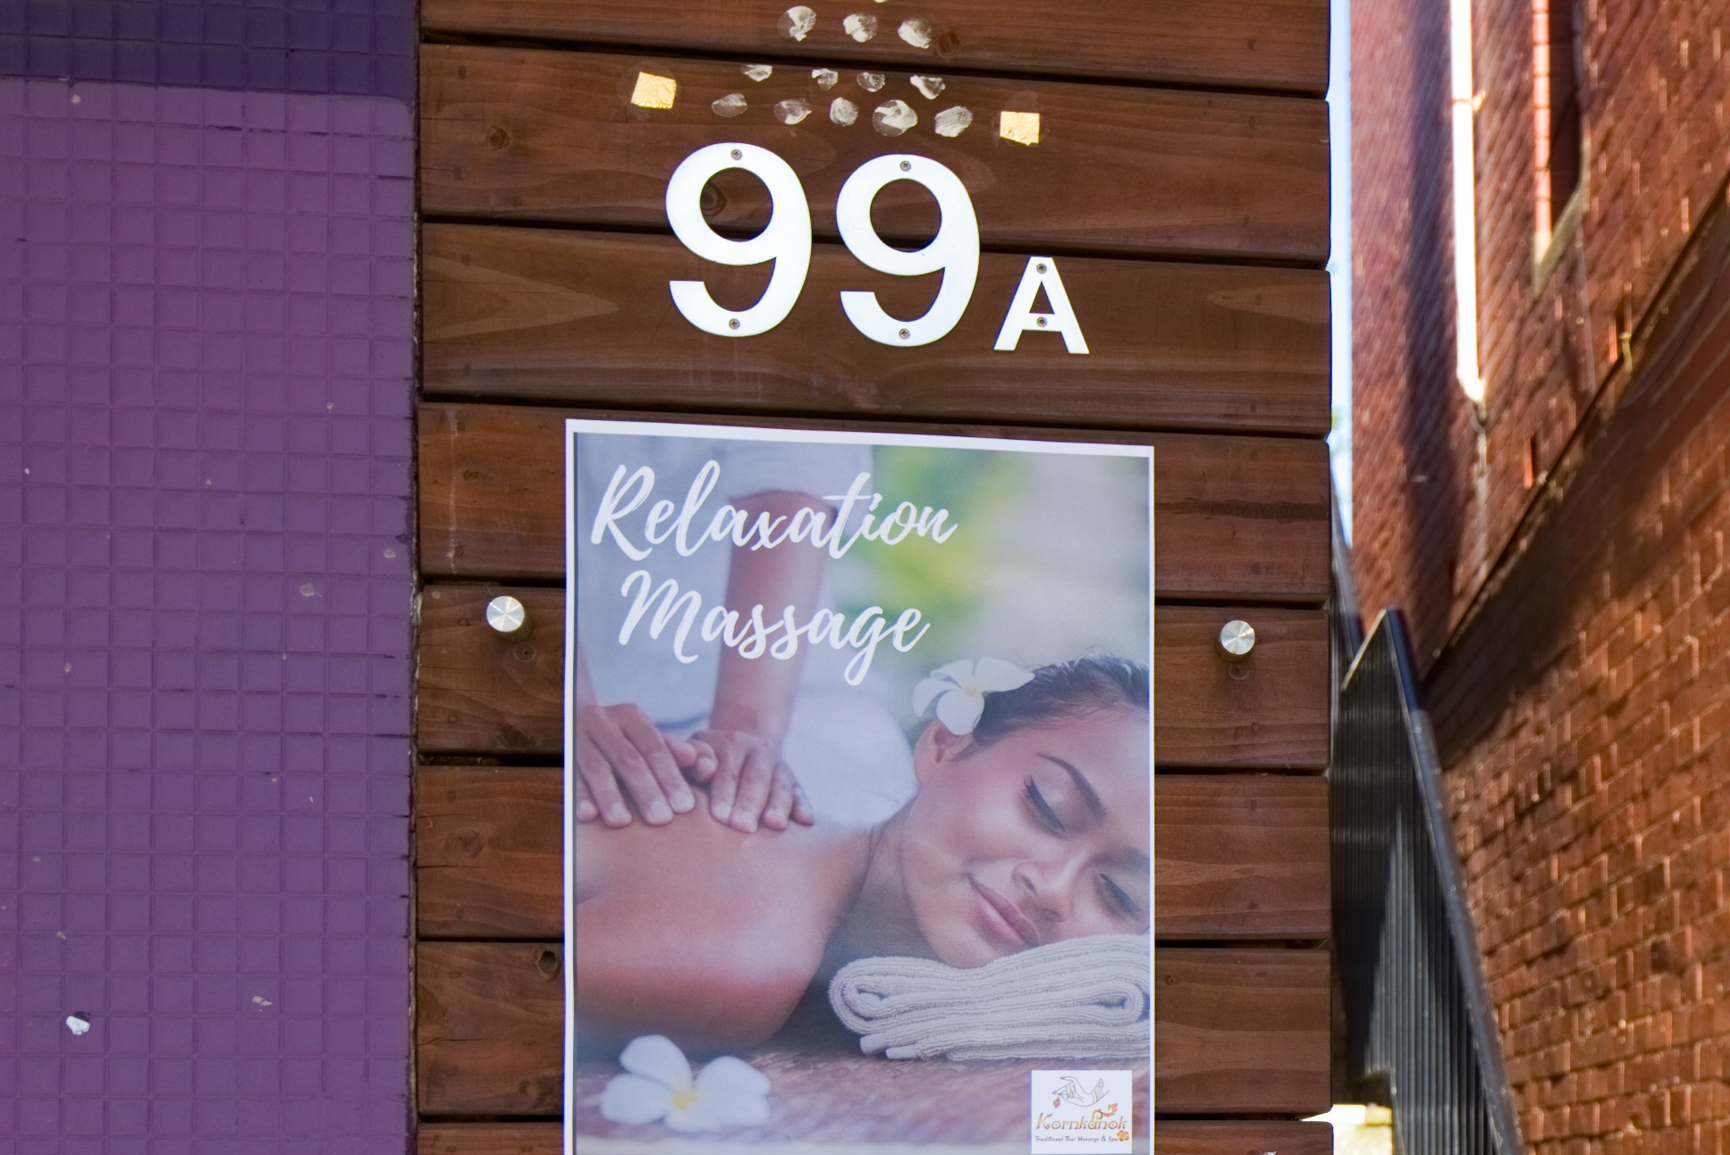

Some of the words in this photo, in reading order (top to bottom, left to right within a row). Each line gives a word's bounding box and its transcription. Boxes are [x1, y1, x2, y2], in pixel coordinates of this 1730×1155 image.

[665, 142, 1090, 355] 99A
[590, 459, 958, 561] Relaxation
[619, 569, 931, 686] Massage
[1036, 1104, 1127, 1130] Kornkanok
